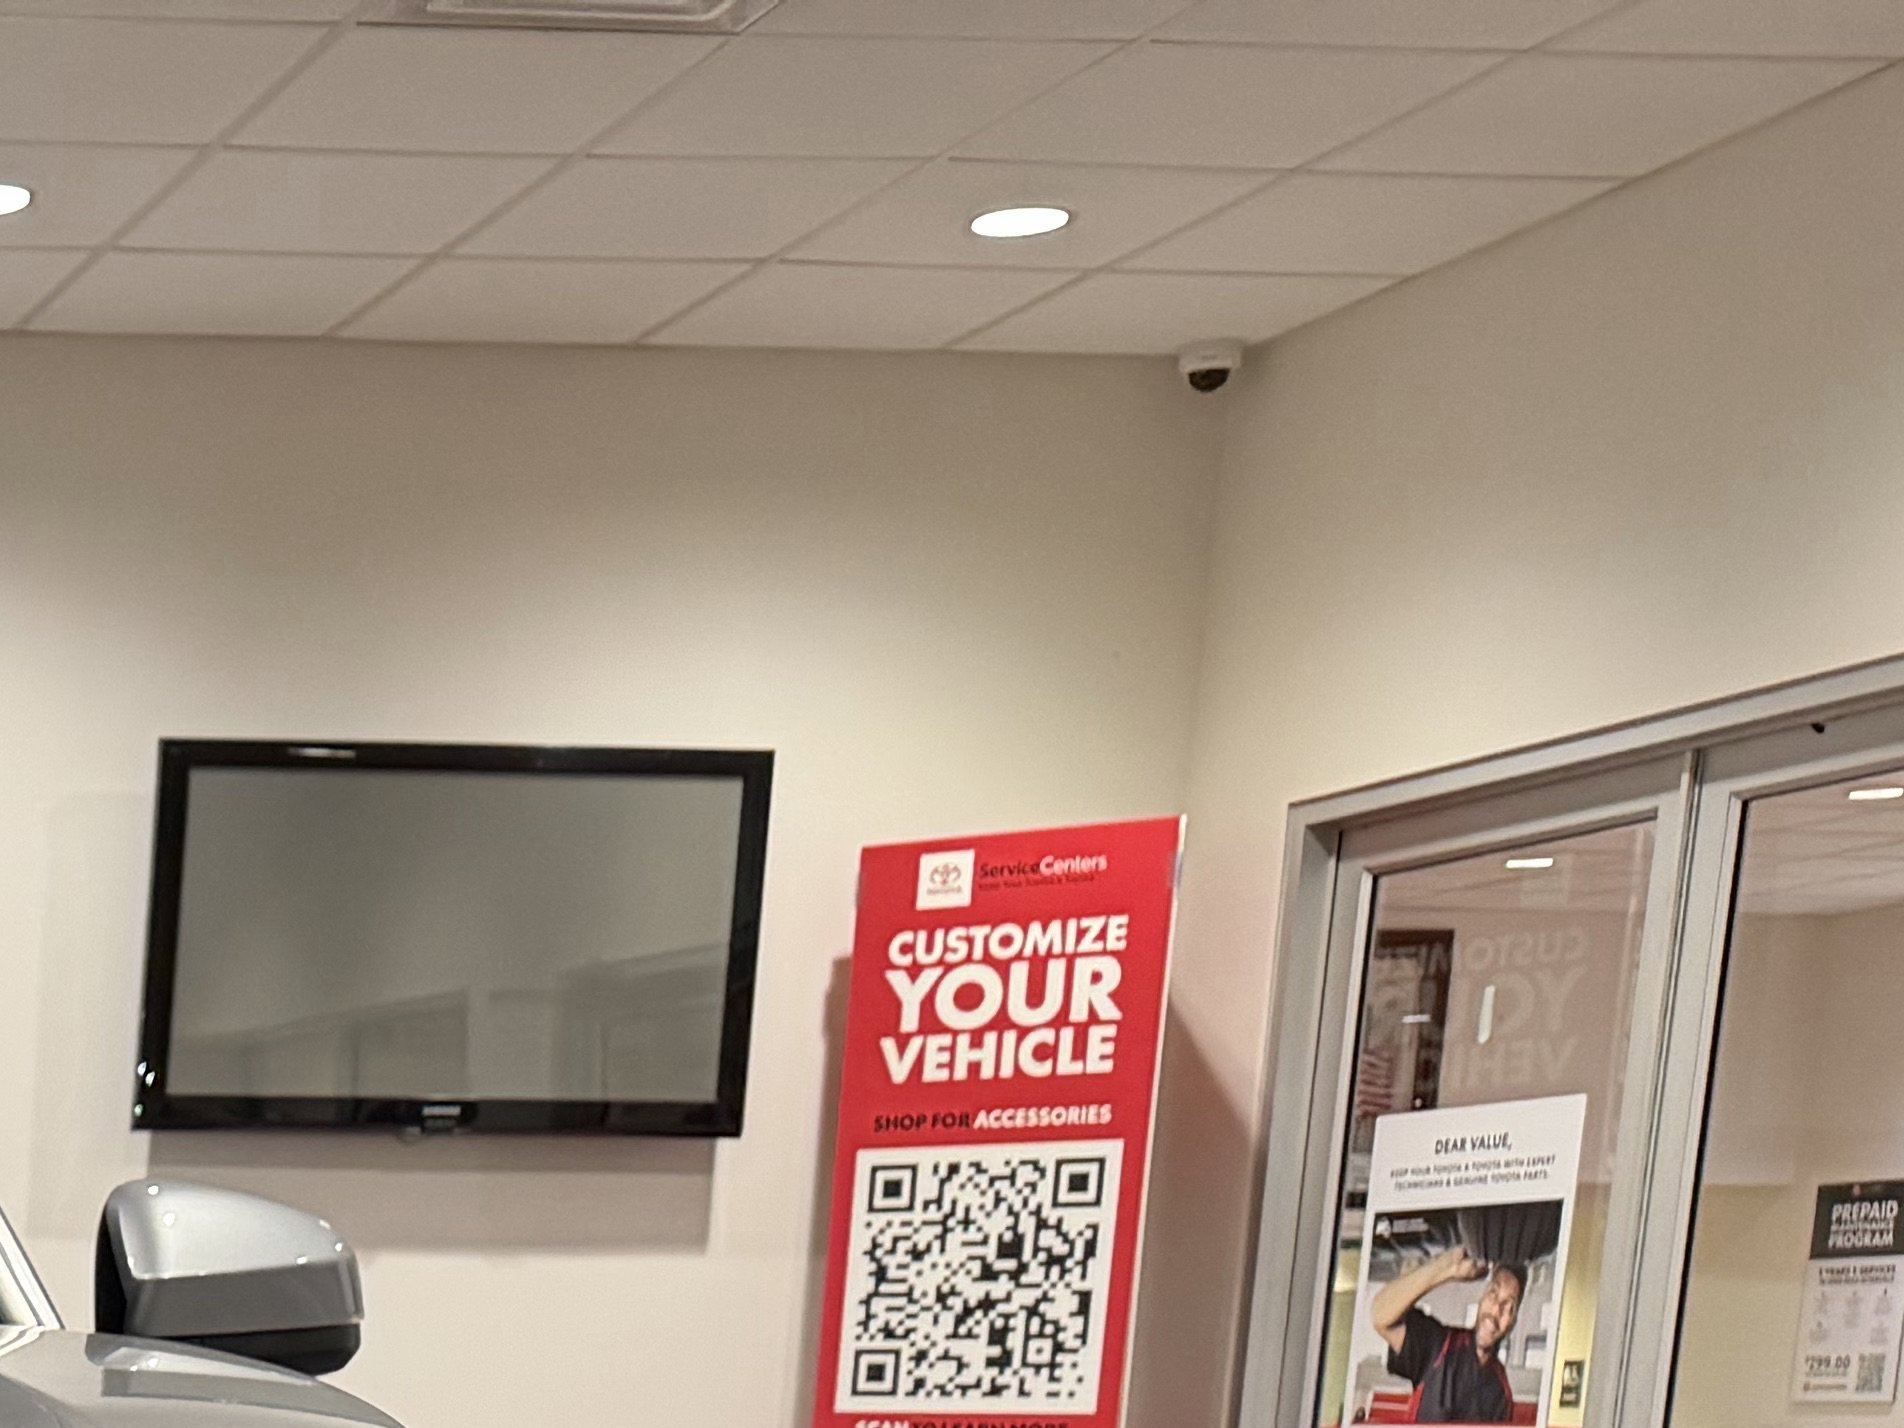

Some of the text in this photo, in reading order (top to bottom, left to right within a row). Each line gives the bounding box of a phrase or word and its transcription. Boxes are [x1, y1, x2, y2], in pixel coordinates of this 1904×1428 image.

[888, 914, 1130, 967] CUSTOMIZE
[884, 955, 1123, 1034] YOUR
[879, 1023, 1117, 1085] VEHICLE
[873, 1103, 1112, 1133] SHOP FOR ACCESSORIES
[1434, 1132, 1512, 1155] DEAR VALUE,
[1832, 1200, 1899, 1223] PREPAID
[1828, 1230, 1894, 1249] PROGRAM
